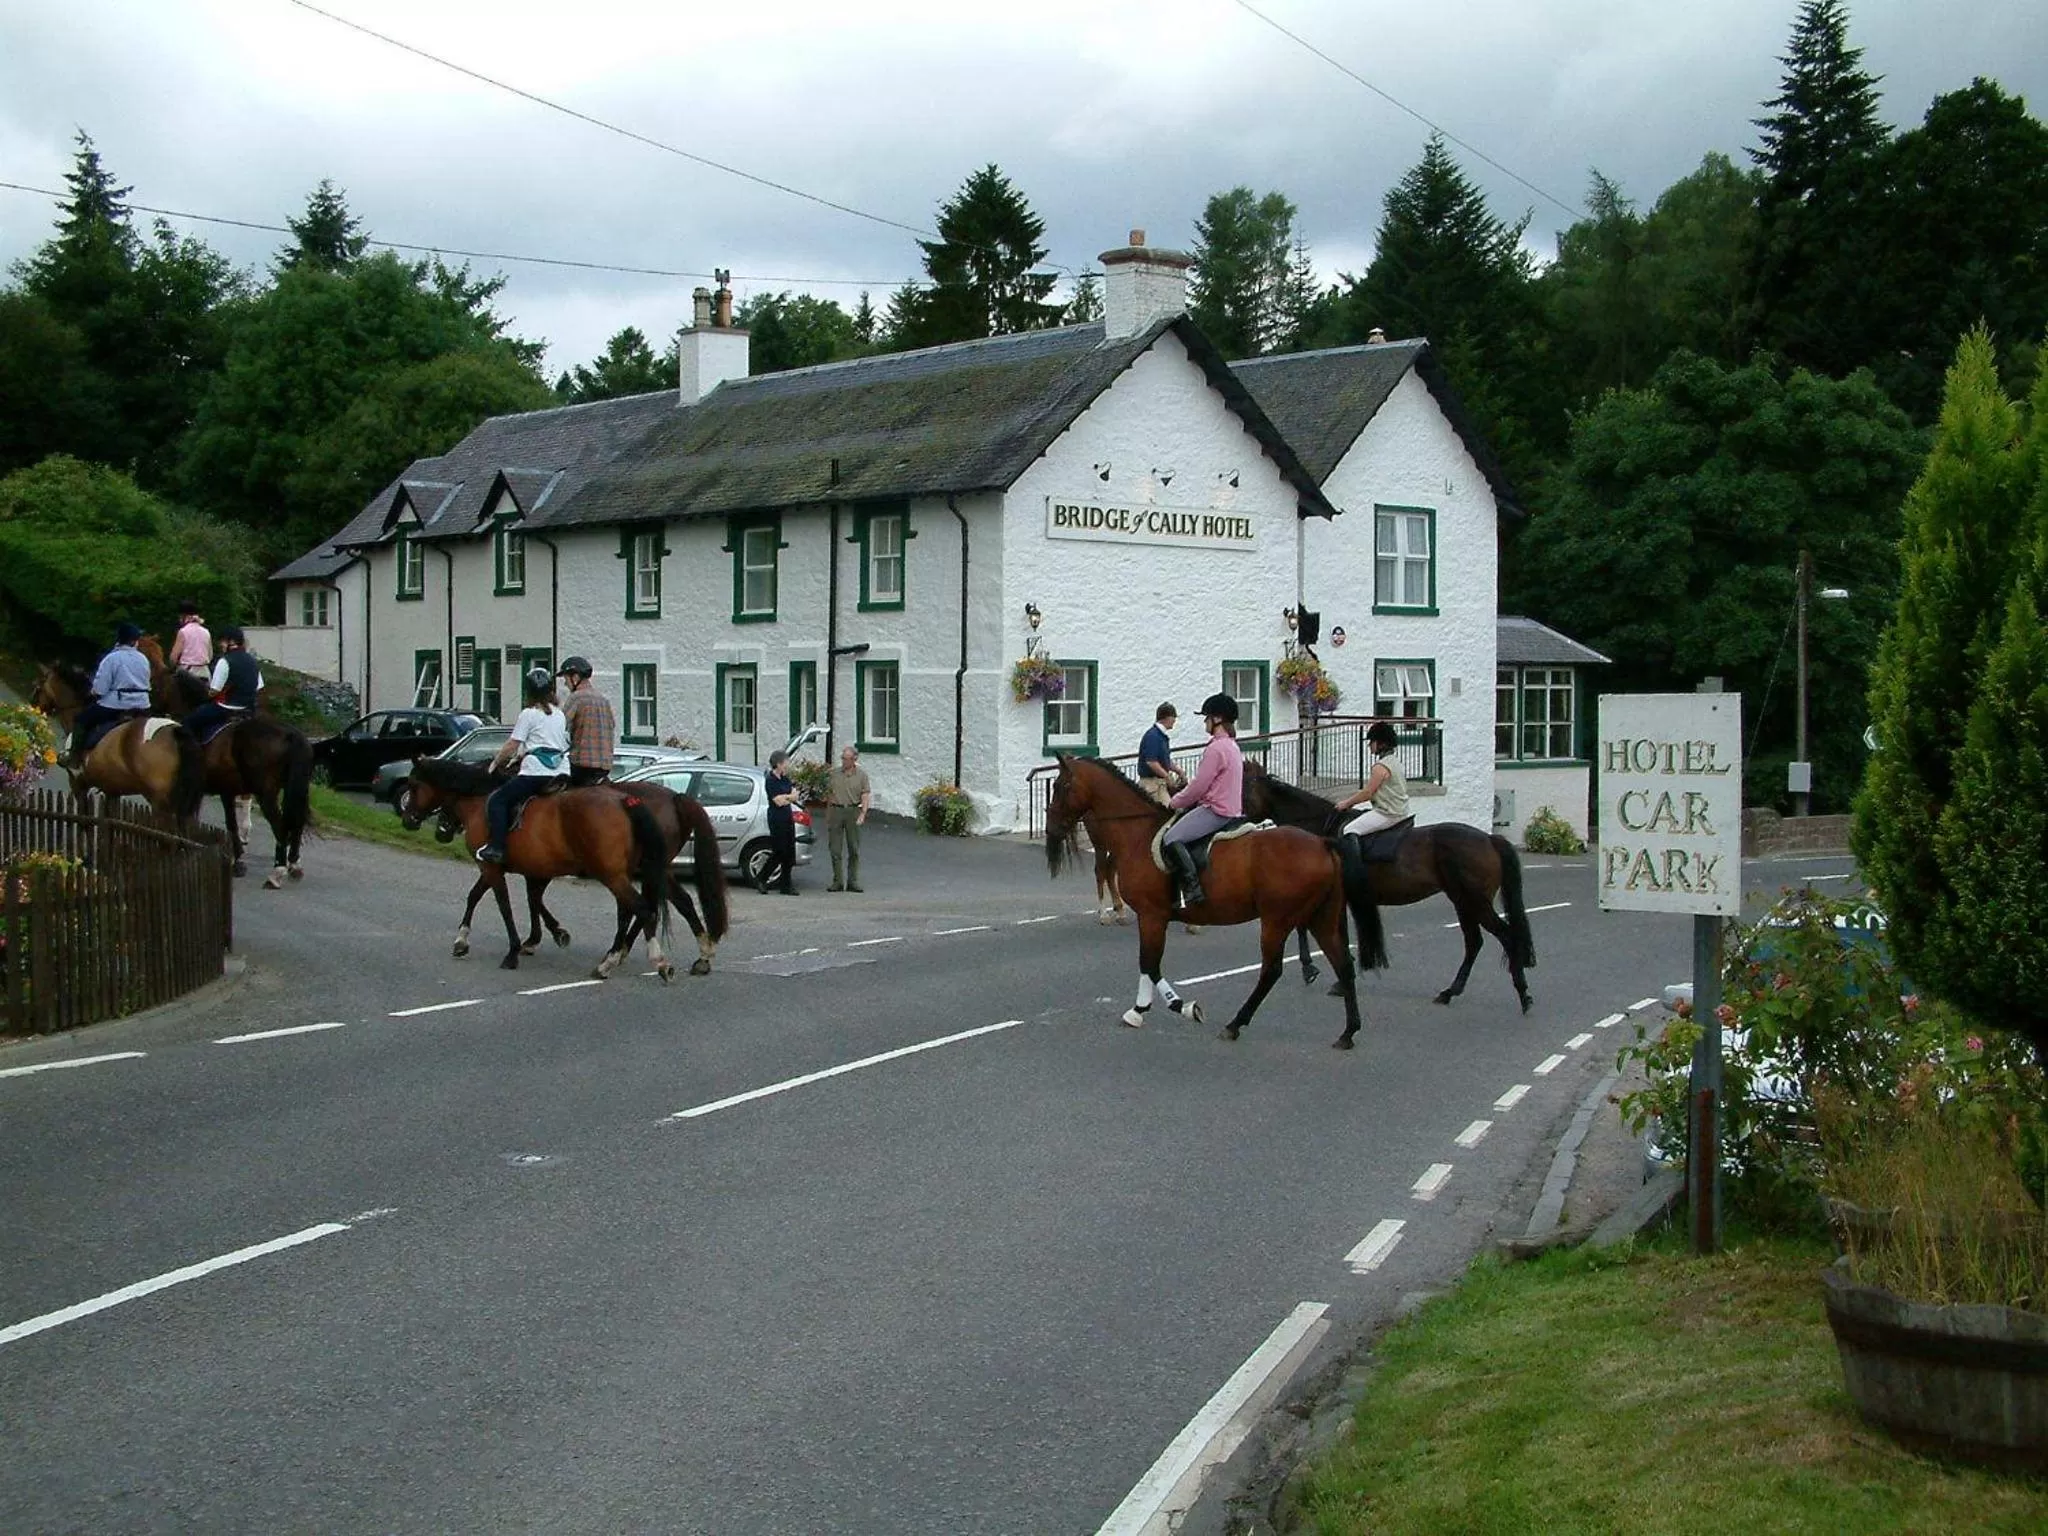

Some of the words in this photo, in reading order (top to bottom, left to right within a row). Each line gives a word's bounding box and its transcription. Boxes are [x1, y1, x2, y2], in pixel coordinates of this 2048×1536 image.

[1055, 504, 1130, 534] BRIDGE
[1149, 511, 1199, 535] CALLY
[1203, 515, 1254, 539] HOTEL
[1603, 739, 1731, 775] HOTEL
[1617, 788, 1716, 836] CAR
[1602, 846, 1725, 894] PARK
